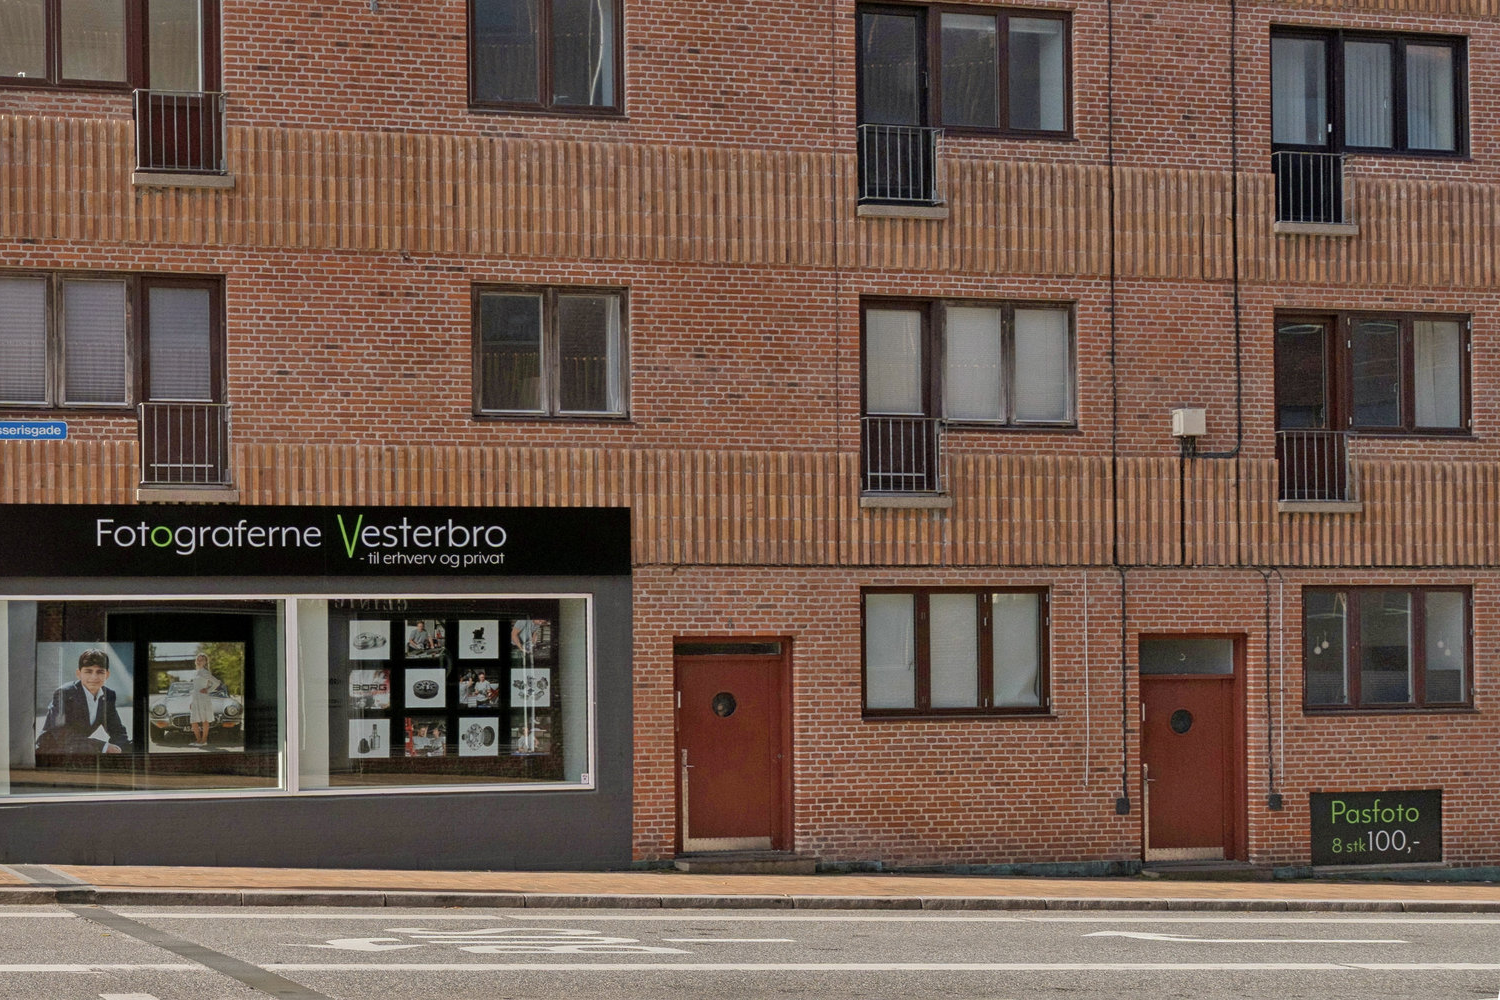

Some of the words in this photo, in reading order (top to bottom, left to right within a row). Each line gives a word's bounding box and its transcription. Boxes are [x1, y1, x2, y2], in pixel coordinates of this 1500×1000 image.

[96, 518, 322, 556] Fotograferne
[336, 513, 508, 559] Vesterbro
[367, 551, 380, 565] til
[382, 551, 437, 565] erhverv
[439, 554, 461, 568] og
[463, 551, 505, 568] privat
[1331, 798, 1420, 824] Pasfoto
[1331, 837, 1343, 854] 8
[1346, 837, 1366, 853] stk
[1367, 829, 1421, 854] 100,-
